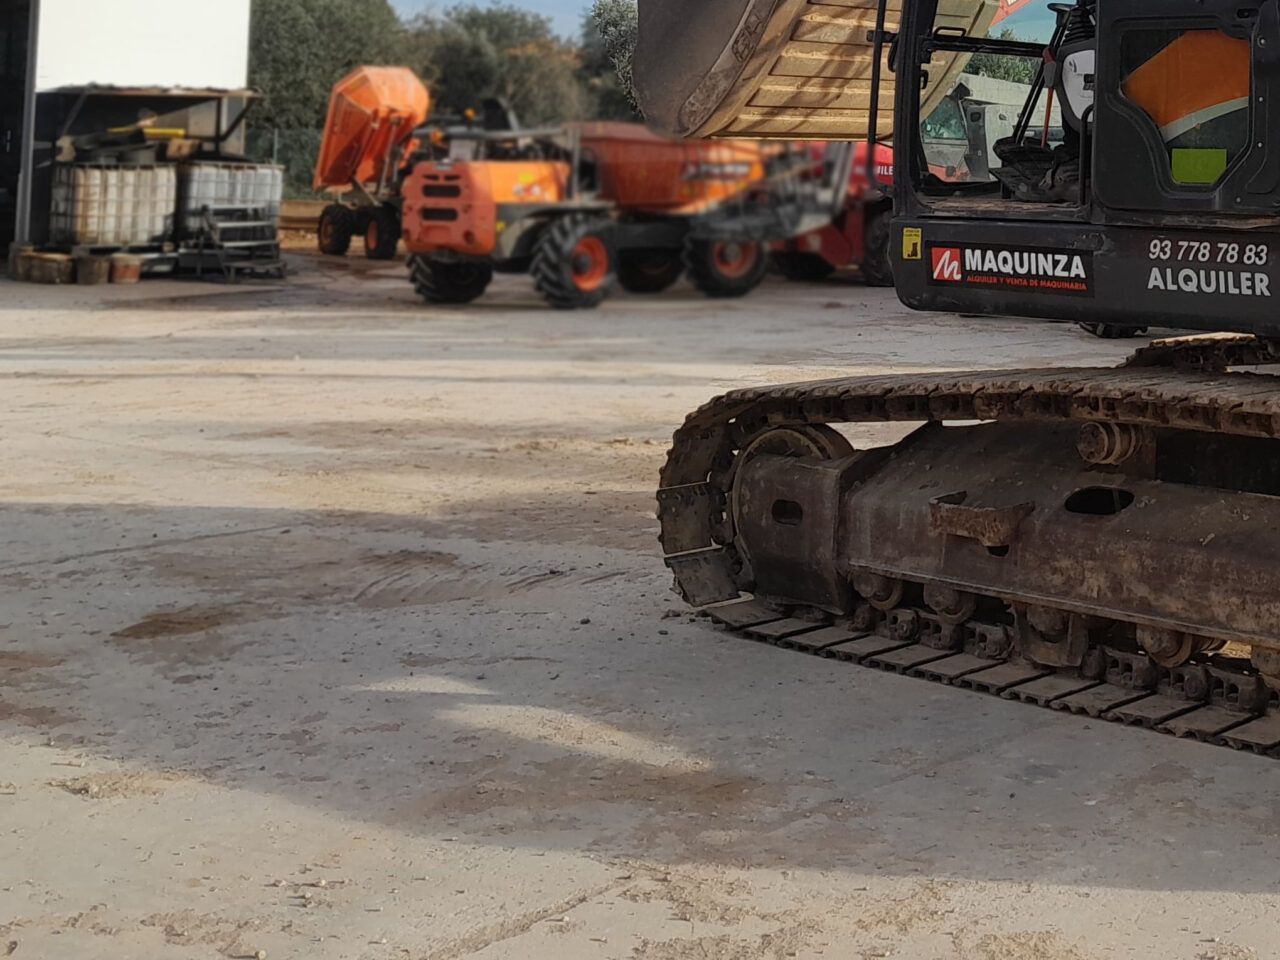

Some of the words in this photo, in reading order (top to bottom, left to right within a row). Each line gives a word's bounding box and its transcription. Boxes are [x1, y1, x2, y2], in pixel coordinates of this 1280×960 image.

[965, 248, 1087, 279] MAQUINZA
[1148, 239, 1172, 260] 93
[1177, 240, 1211, 262] 778
[1216, 242, 1239, 264] 78
[1243, 244, 1268, 265] 83
[967, 274, 998, 284] ALQUILER
[1005, 277, 1028, 287] VENTA
[1029, 279, 1038, 287] DE
[1040, 280, 1088, 290] MAQUINARIA
[1147, 266, 1271, 296] ALQUILER
